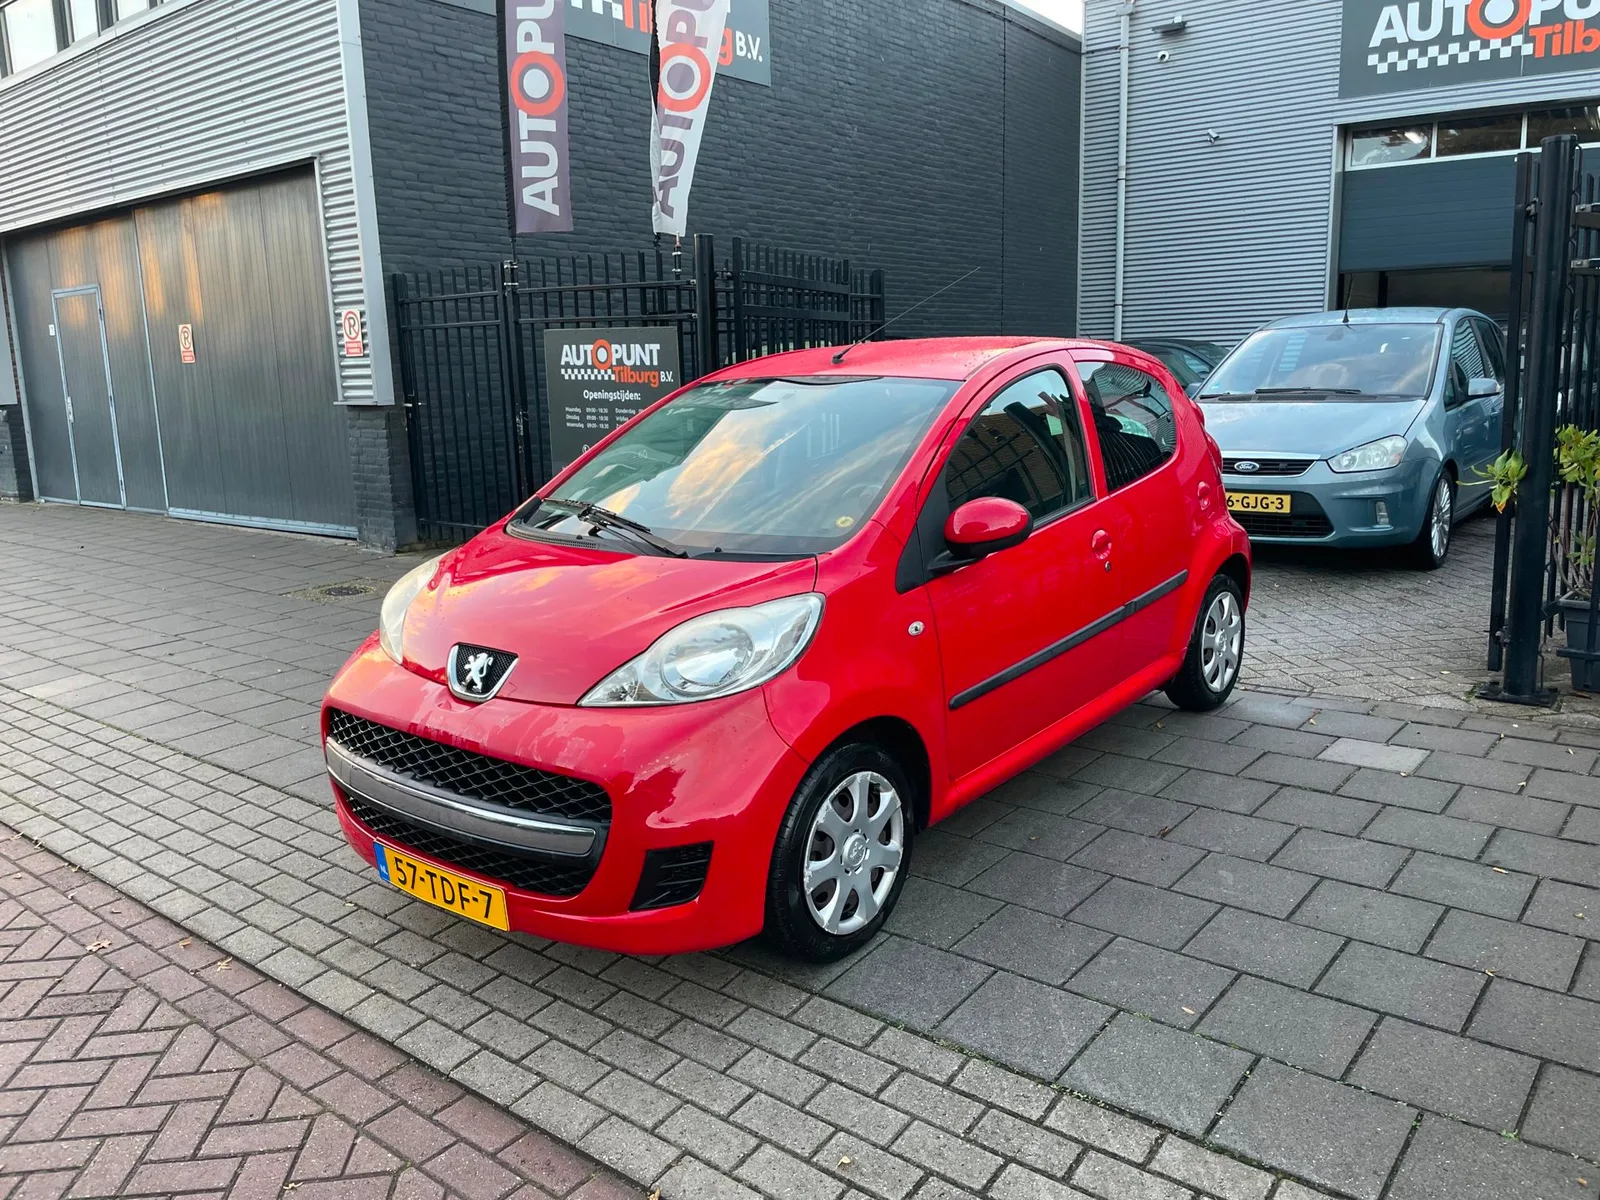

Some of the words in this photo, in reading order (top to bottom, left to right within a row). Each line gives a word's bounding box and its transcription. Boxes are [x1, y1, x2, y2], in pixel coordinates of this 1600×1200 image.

[735, 30, 763, 62] B.V.
[560, 338, 660, 370] AUTOPUNT
[612, 365, 660, 388] Tilburg
[660, 371, 674, 383] B.V.
[583, 390, 641, 401] Openingstijden:
[394, 857, 492, 919] 57-TDF-7
